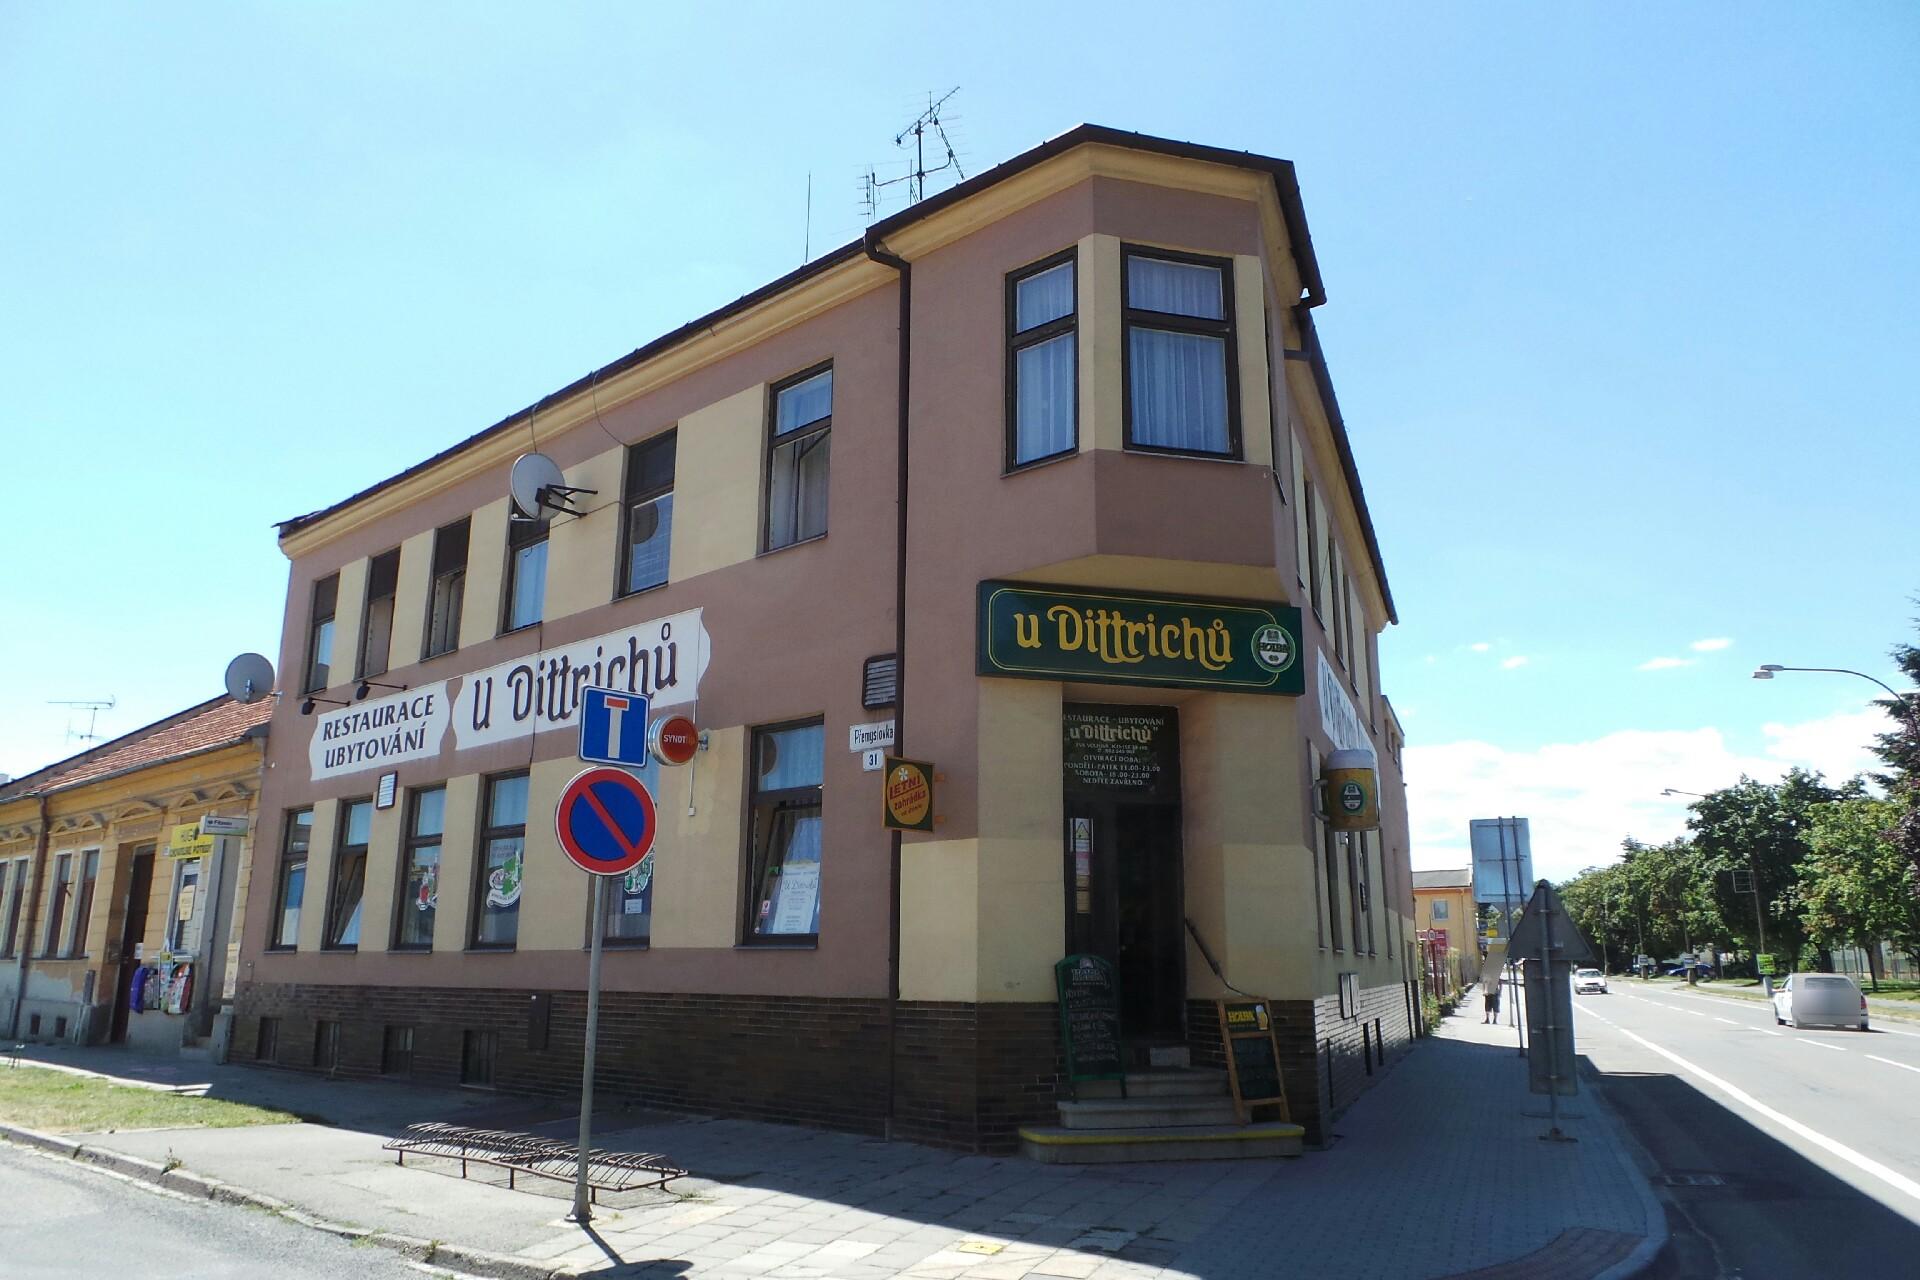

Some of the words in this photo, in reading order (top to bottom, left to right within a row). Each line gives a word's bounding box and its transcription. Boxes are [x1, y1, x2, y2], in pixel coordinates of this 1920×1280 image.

[1046, 605, 1234, 671] Dittrichů
[322, 693, 434, 742] RESTAURACE
[854, 723, 894, 745] Přemyslovka
[324, 721, 427, 769] UBYTOVÁNÍ
[663, 734, 686, 744] SYNOT
[868, 753, 878, 766] 31
